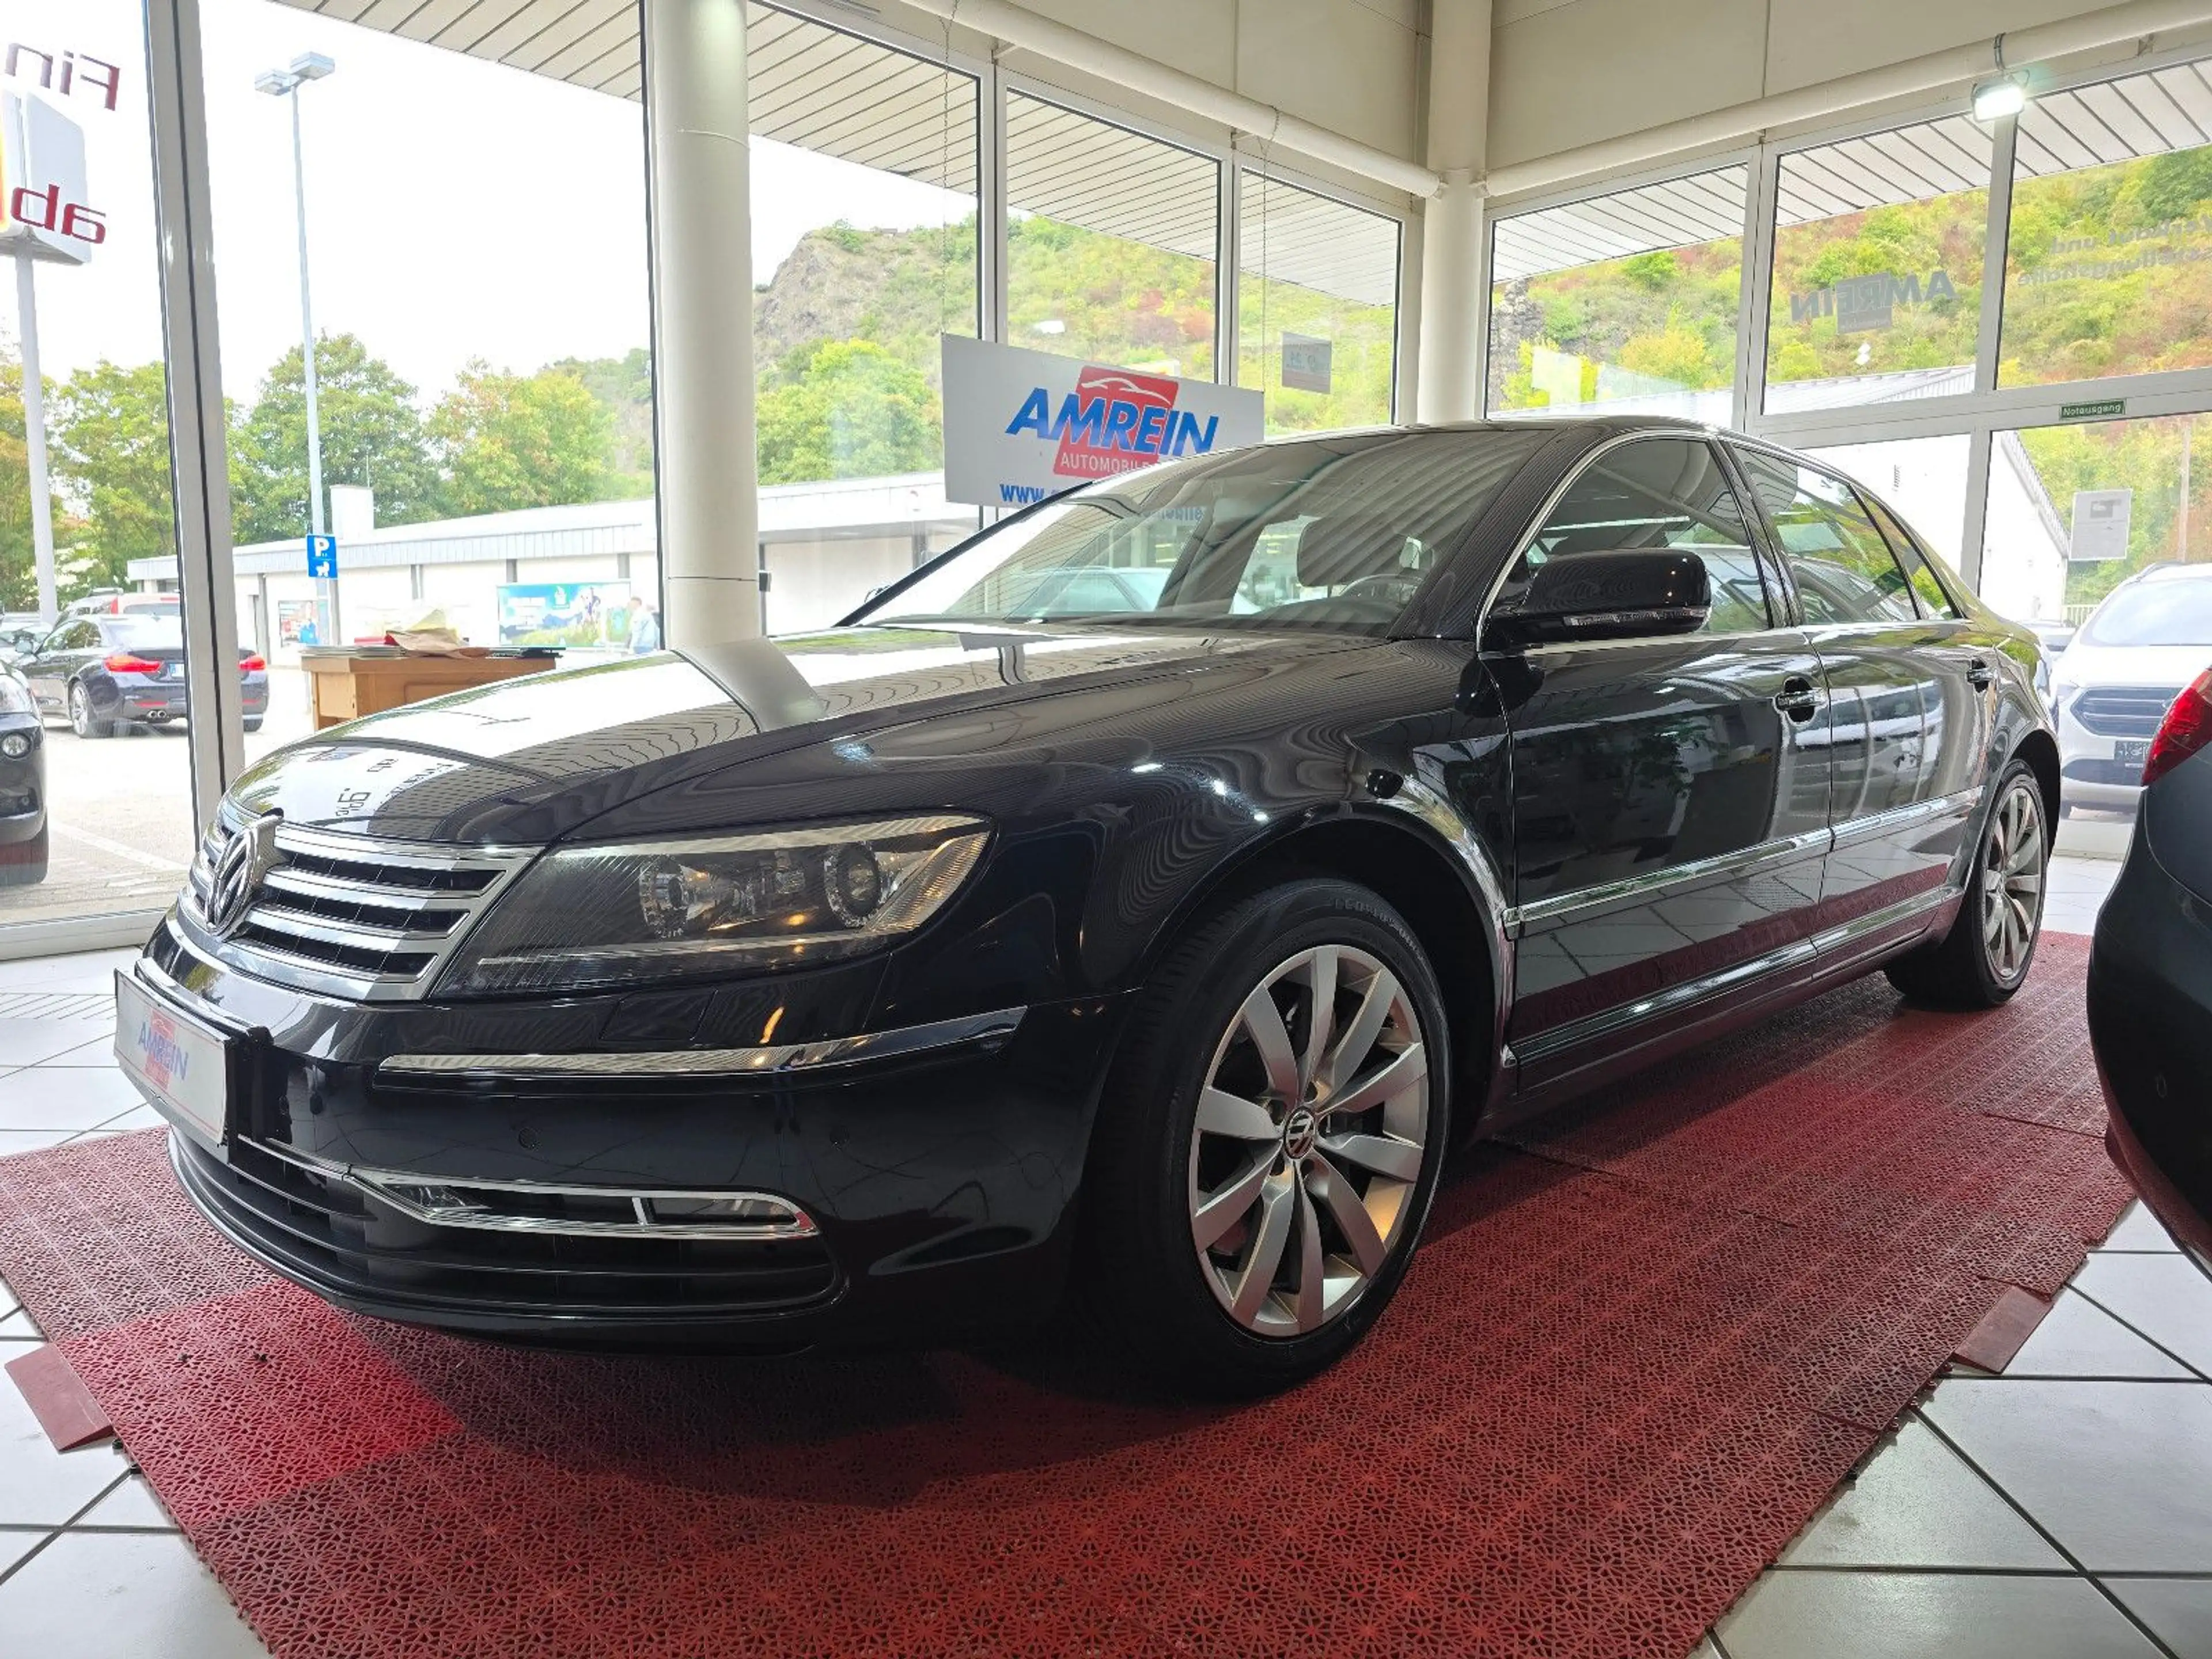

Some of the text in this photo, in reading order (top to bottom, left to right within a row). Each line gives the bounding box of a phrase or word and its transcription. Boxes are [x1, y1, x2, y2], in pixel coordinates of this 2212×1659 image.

[1005, 387, 1218, 457] AMREIN
[2063, 404, 2122, 415] Notausgang
[314, 537, 329, 558] P
[138, 1021, 188, 1081] AMREIN
